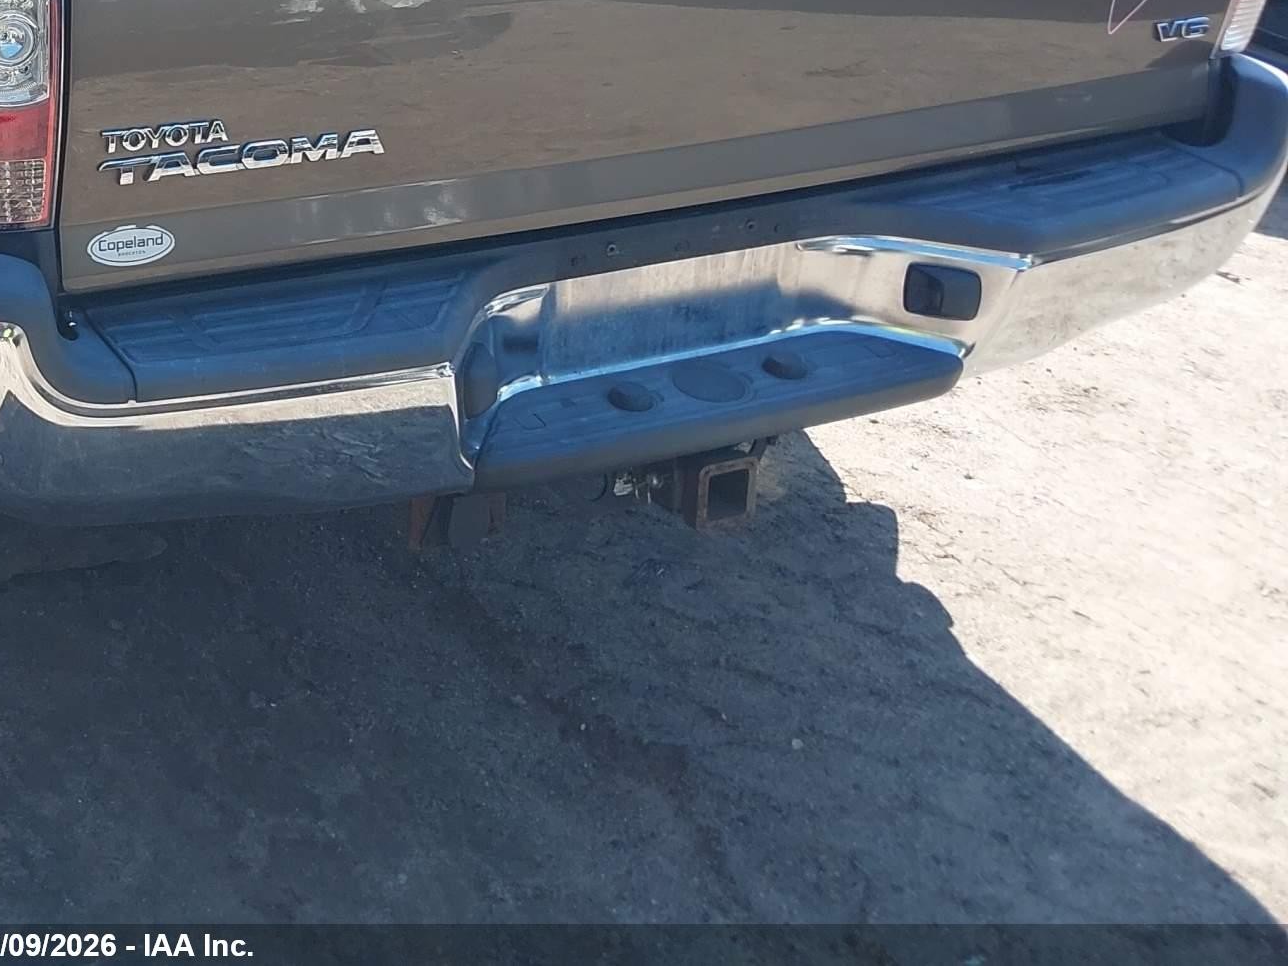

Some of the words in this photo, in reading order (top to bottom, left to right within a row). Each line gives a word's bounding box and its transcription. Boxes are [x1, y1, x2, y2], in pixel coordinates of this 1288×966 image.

[1156, 16, 1210, 42] V6
[101, 119, 229, 154] TOYOTA
[98, 129, 385, 185] TACOMA
[98, 233, 164, 252] Copeland
